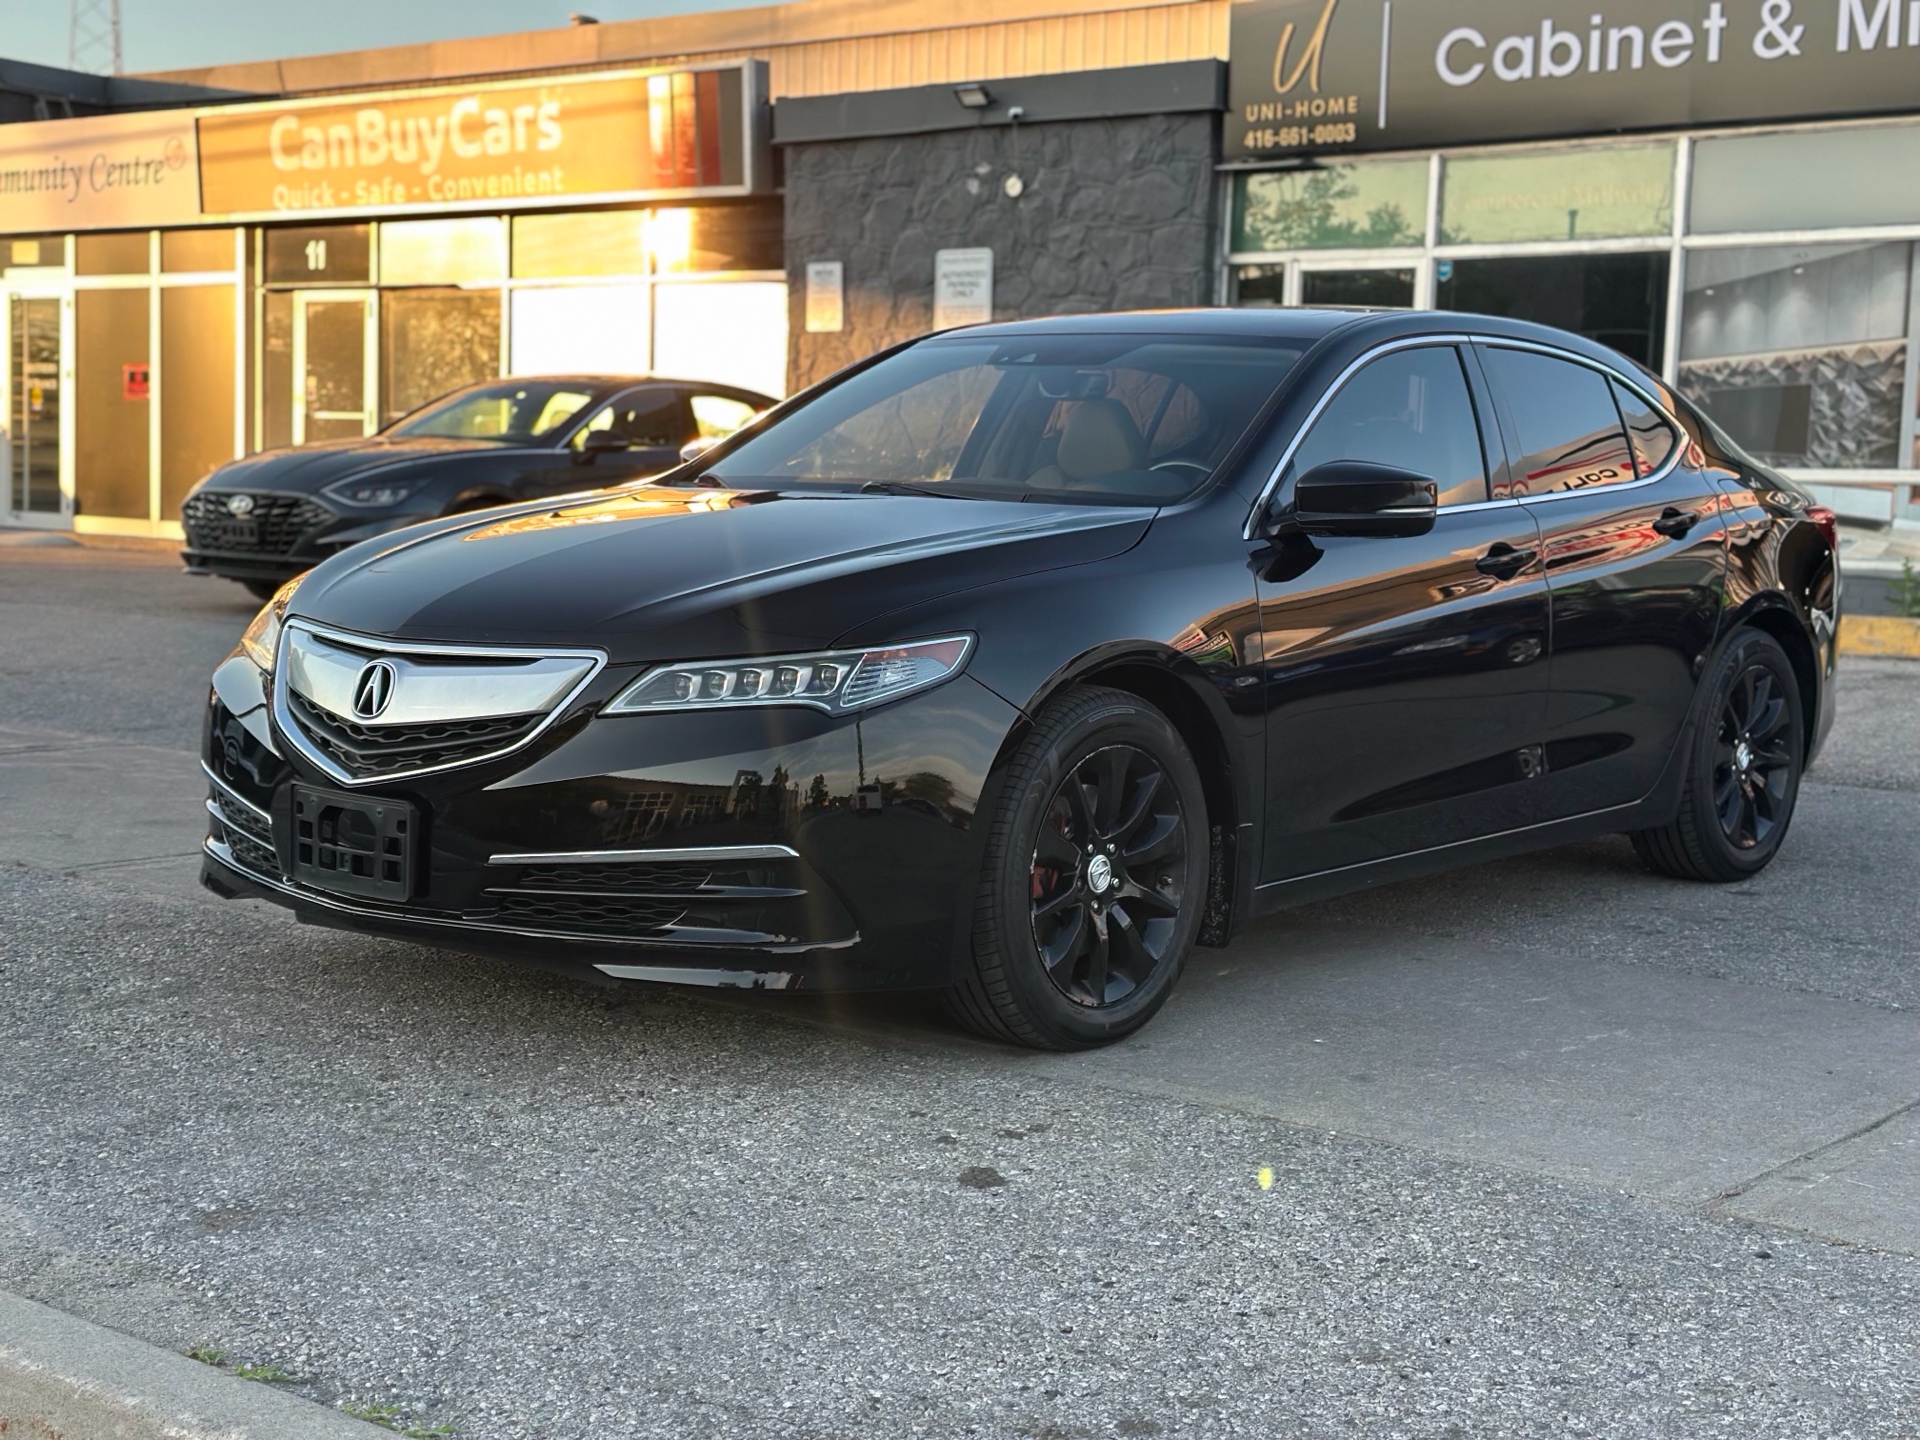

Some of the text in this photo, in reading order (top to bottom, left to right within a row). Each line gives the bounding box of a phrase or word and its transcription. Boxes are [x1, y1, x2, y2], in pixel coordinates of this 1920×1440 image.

[1435, 2, 1728, 87] Cabinet
[1752, 0, 1805, 60] &
[1245, 95, 1359, 122] UNI-HOME
[269, 96, 563, 176] CanBuyCars
[0, 153, 165, 203] munity Centre
[272, 180, 335, 211] Quick
[354, 175, 406, 206] Safe
[427, 165, 564, 201] Convenient
[305, 240, 327, 270] 11
